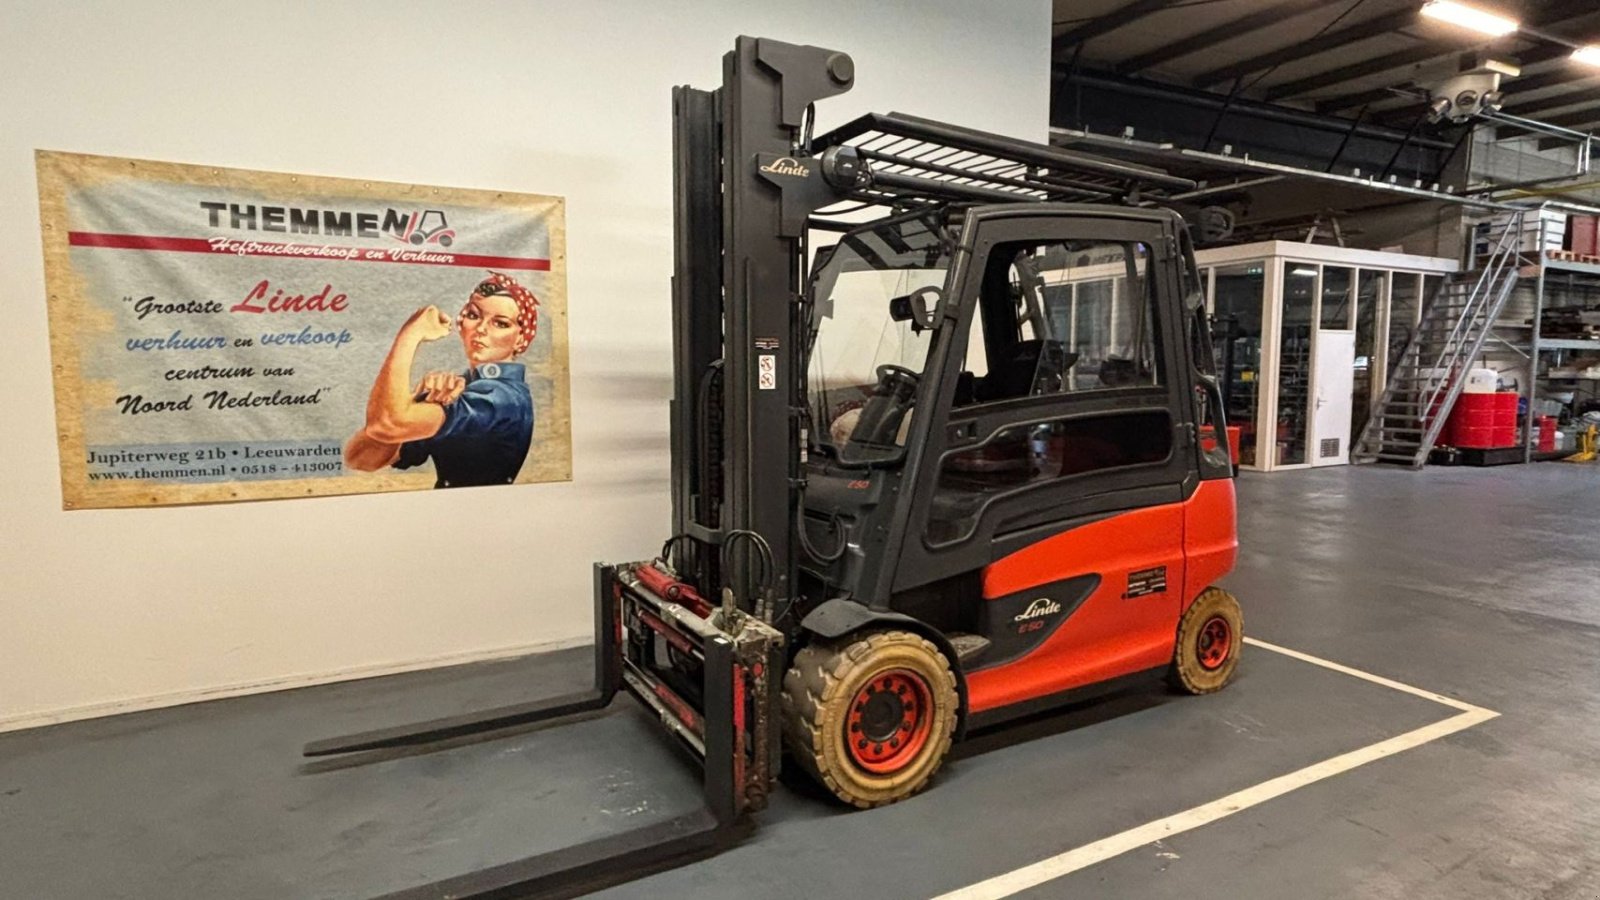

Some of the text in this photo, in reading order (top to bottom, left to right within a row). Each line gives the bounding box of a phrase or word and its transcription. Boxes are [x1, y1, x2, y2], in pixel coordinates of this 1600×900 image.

[760, 157, 810, 177] Linde
[200, 201, 410, 238] THEMMEN
[208, 237, 455, 263] Heftruckverkoop en Verhuur
[230, 279, 349, 314] Linde
[126, 325, 353, 351] verhuur en verkoop
[164, 365, 295, 381] centrum van
[116, 394, 193, 415] Noord
[86, 444, 342, 467] Jupiterweg 21b Leeuwarden
[88, 465, 226, 481] www.themmen.nl
[241, 464, 277, 474] 0518
[291, 461, 343, 473] 413007
[1014, 598, 1061, 621] Linde
